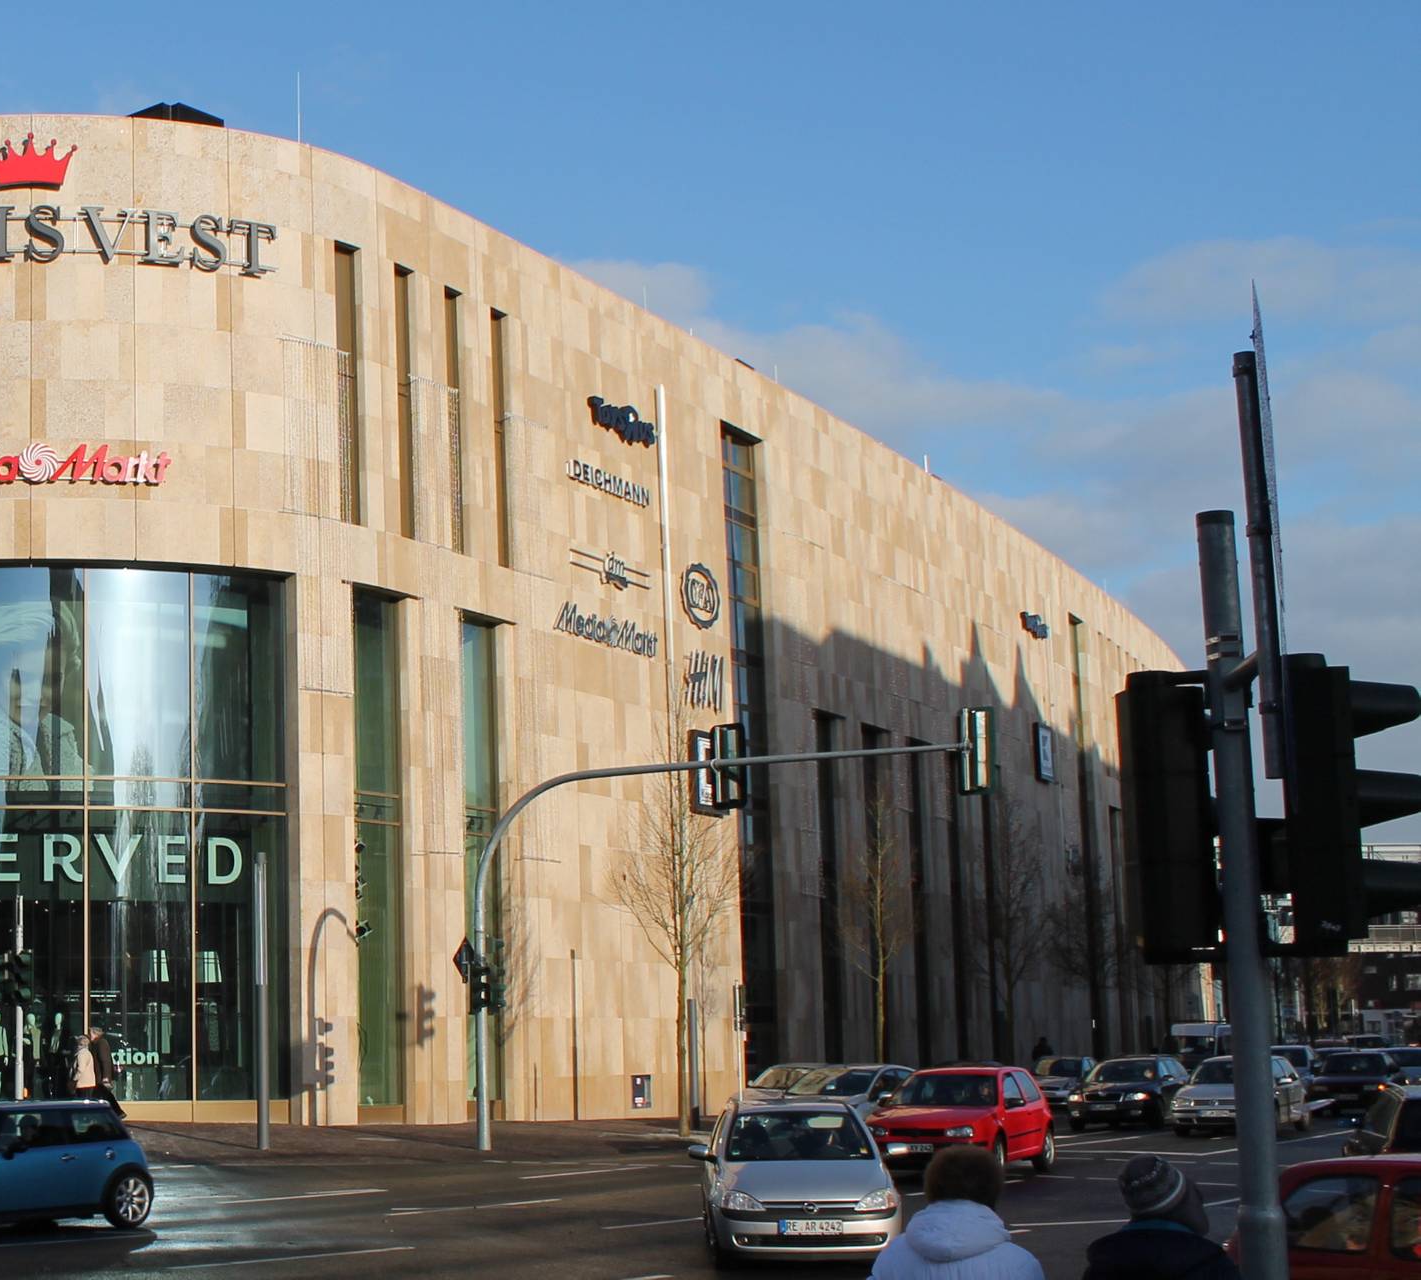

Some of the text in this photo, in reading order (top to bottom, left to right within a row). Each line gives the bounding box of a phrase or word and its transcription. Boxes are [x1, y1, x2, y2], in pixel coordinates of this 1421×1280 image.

[81, 206, 277, 277] VEST
[52, 444, 171, 486] Markt
[568, 459, 649, 507] DEICHMANN
[555, 601, 658, 658] Media Markt
[786, 1221, 842, 1232] RE AR 4242
